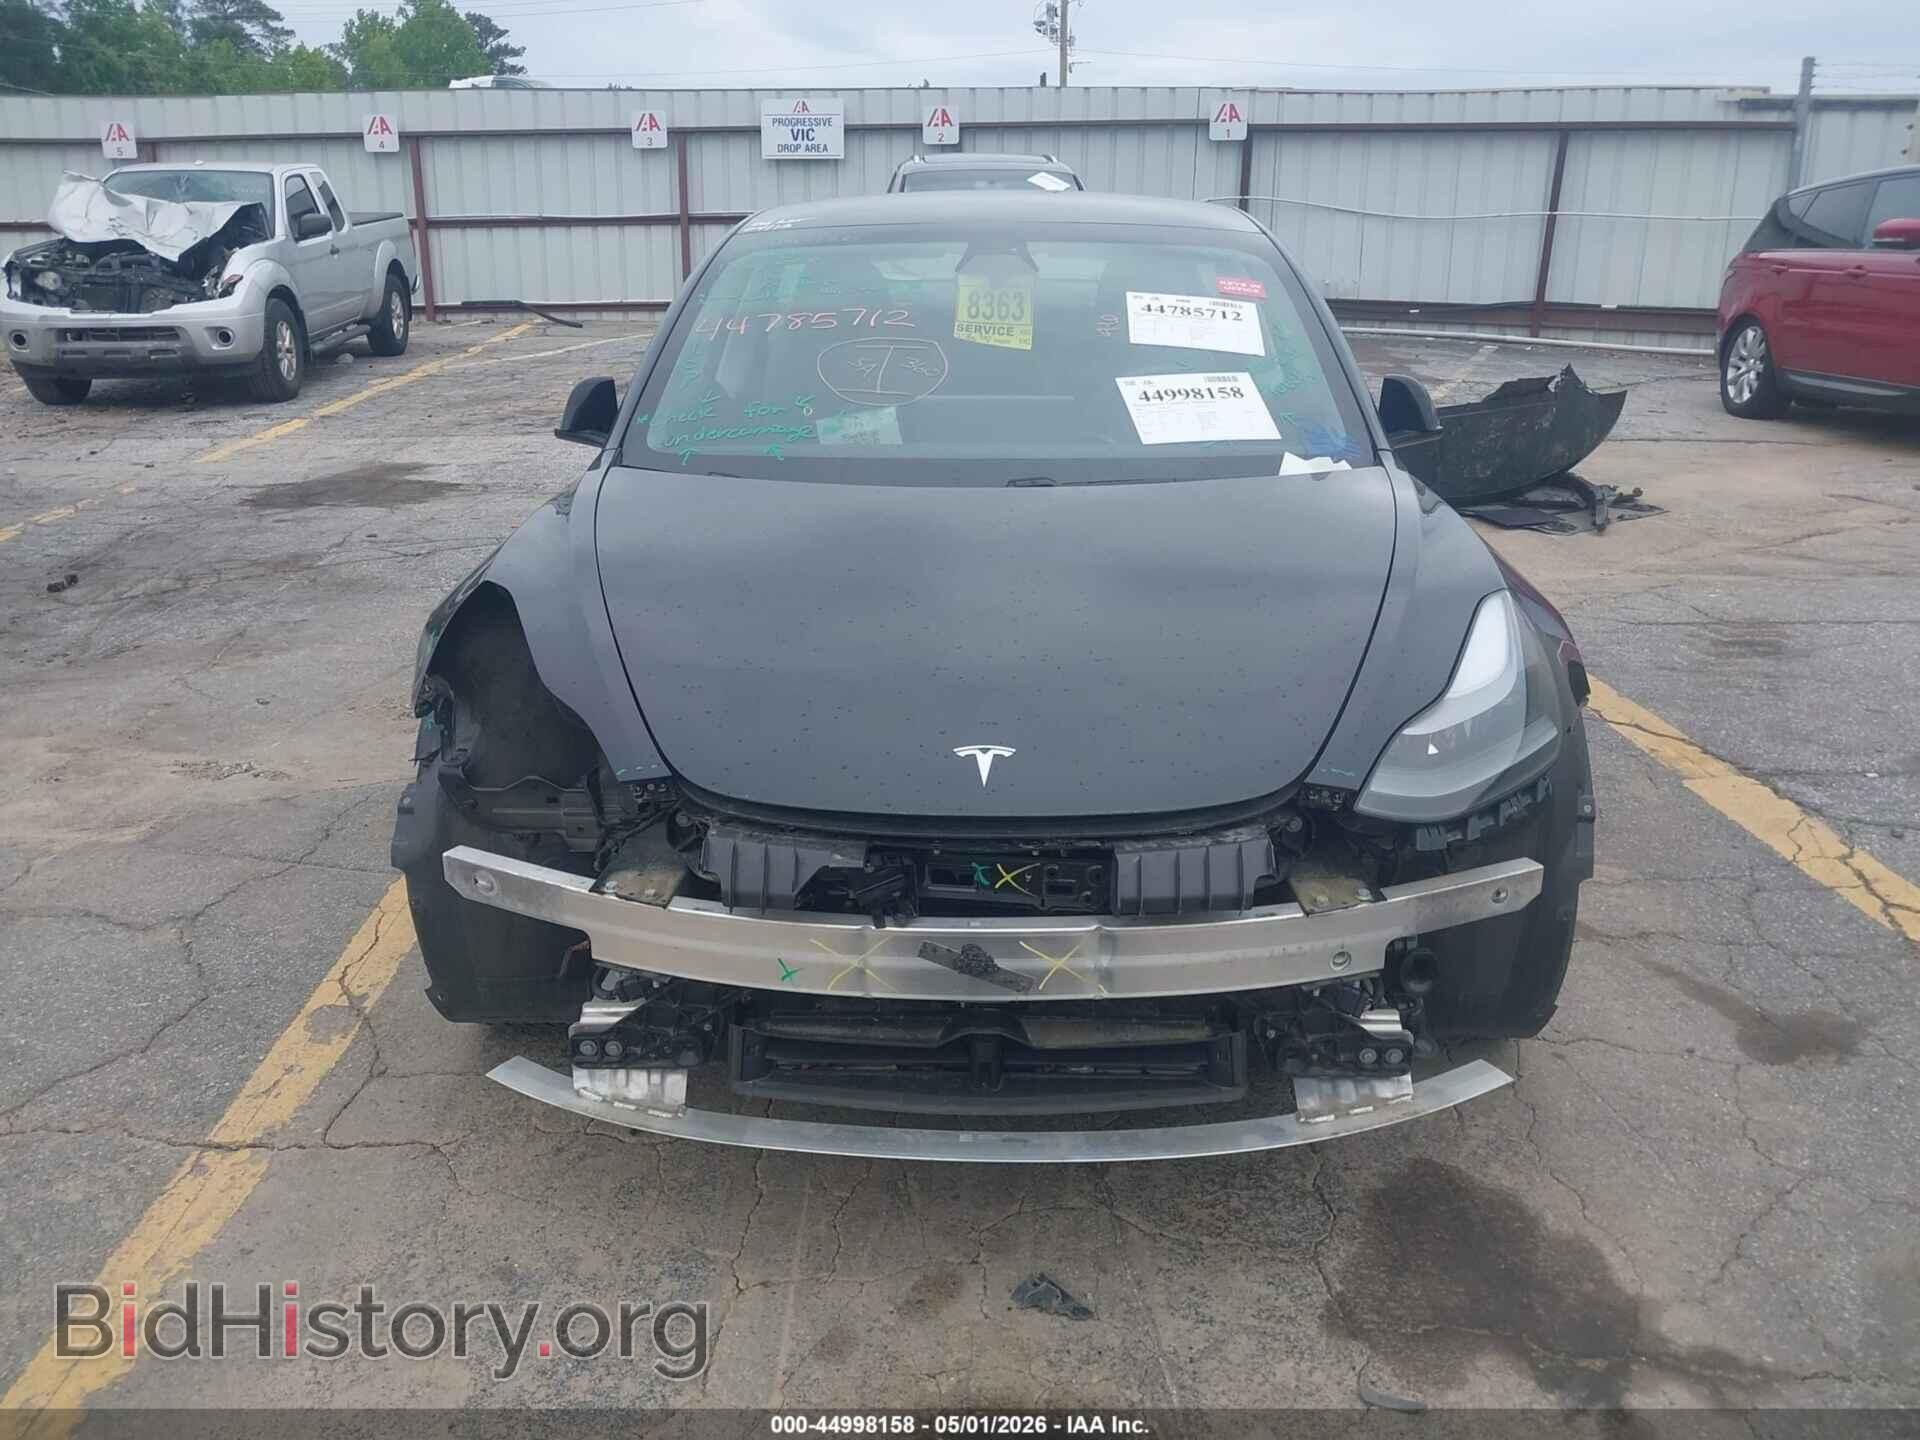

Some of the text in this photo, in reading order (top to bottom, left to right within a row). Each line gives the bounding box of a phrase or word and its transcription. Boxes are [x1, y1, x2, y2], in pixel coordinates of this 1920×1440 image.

[772, 117, 833, 127] PROGRESSIVE
[790, 129, 816, 142] VIC
[937, 132, 945, 142] 2
[1225, 128, 1231, 138] 1
[378, 140, 385, 149] 4
[645, 136, 653, 146] 3
[116, 146, 124, 156] 5
[777, 143, 829, 153] DROP AREA
[967, 290, 1025, 320] 8363
[1140, 303, 1243, 321] 44785712
[696, 307, 916, 341] 44785712
[956, 322, 1015, 337] SERVICE
[1138, 386, 1244, 402] 44998158
